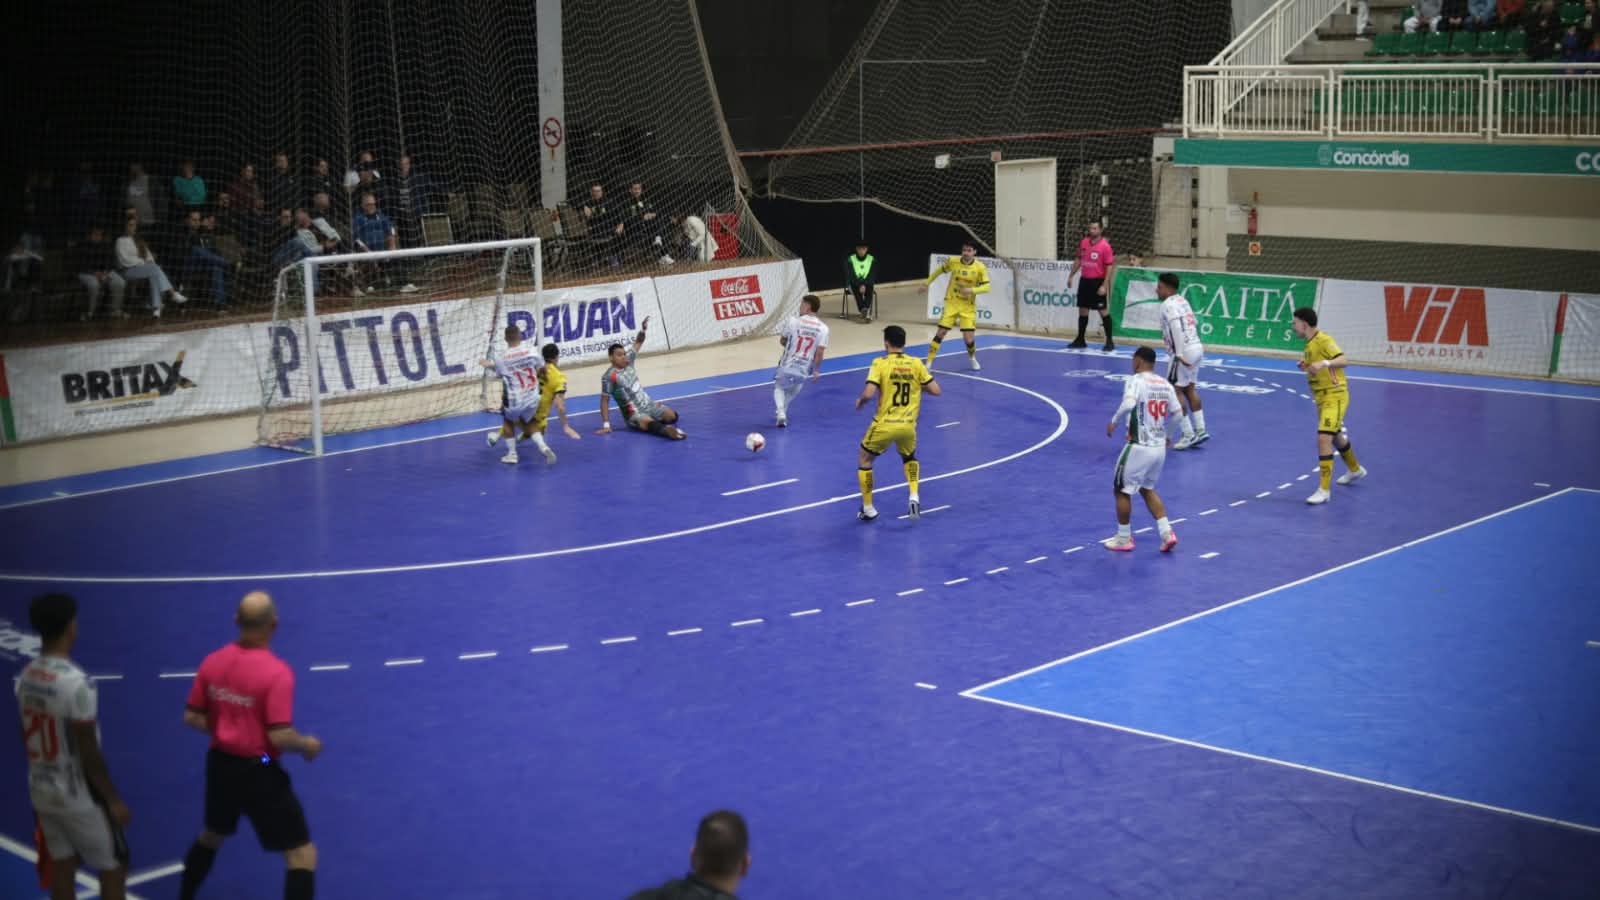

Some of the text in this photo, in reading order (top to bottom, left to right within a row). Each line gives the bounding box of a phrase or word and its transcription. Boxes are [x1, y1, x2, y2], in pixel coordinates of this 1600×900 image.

[1333, 149, 1409, 166] Concórdia
[718, 299, 761, 318] FEMSA
[1181, 283, 1297, 323] CAITÁ
[507, 293, 636, 343] PAVAN
[1200, 322, 1292, 342] OTÉIS
[1385, 345, 1485, 360] ATACADISTA
[513, 367, 537, 389] 13
[892, 382, 910, 406] 28
[1147, 399, 1169, 421] 99
[23, 707, 59, 762] 20
